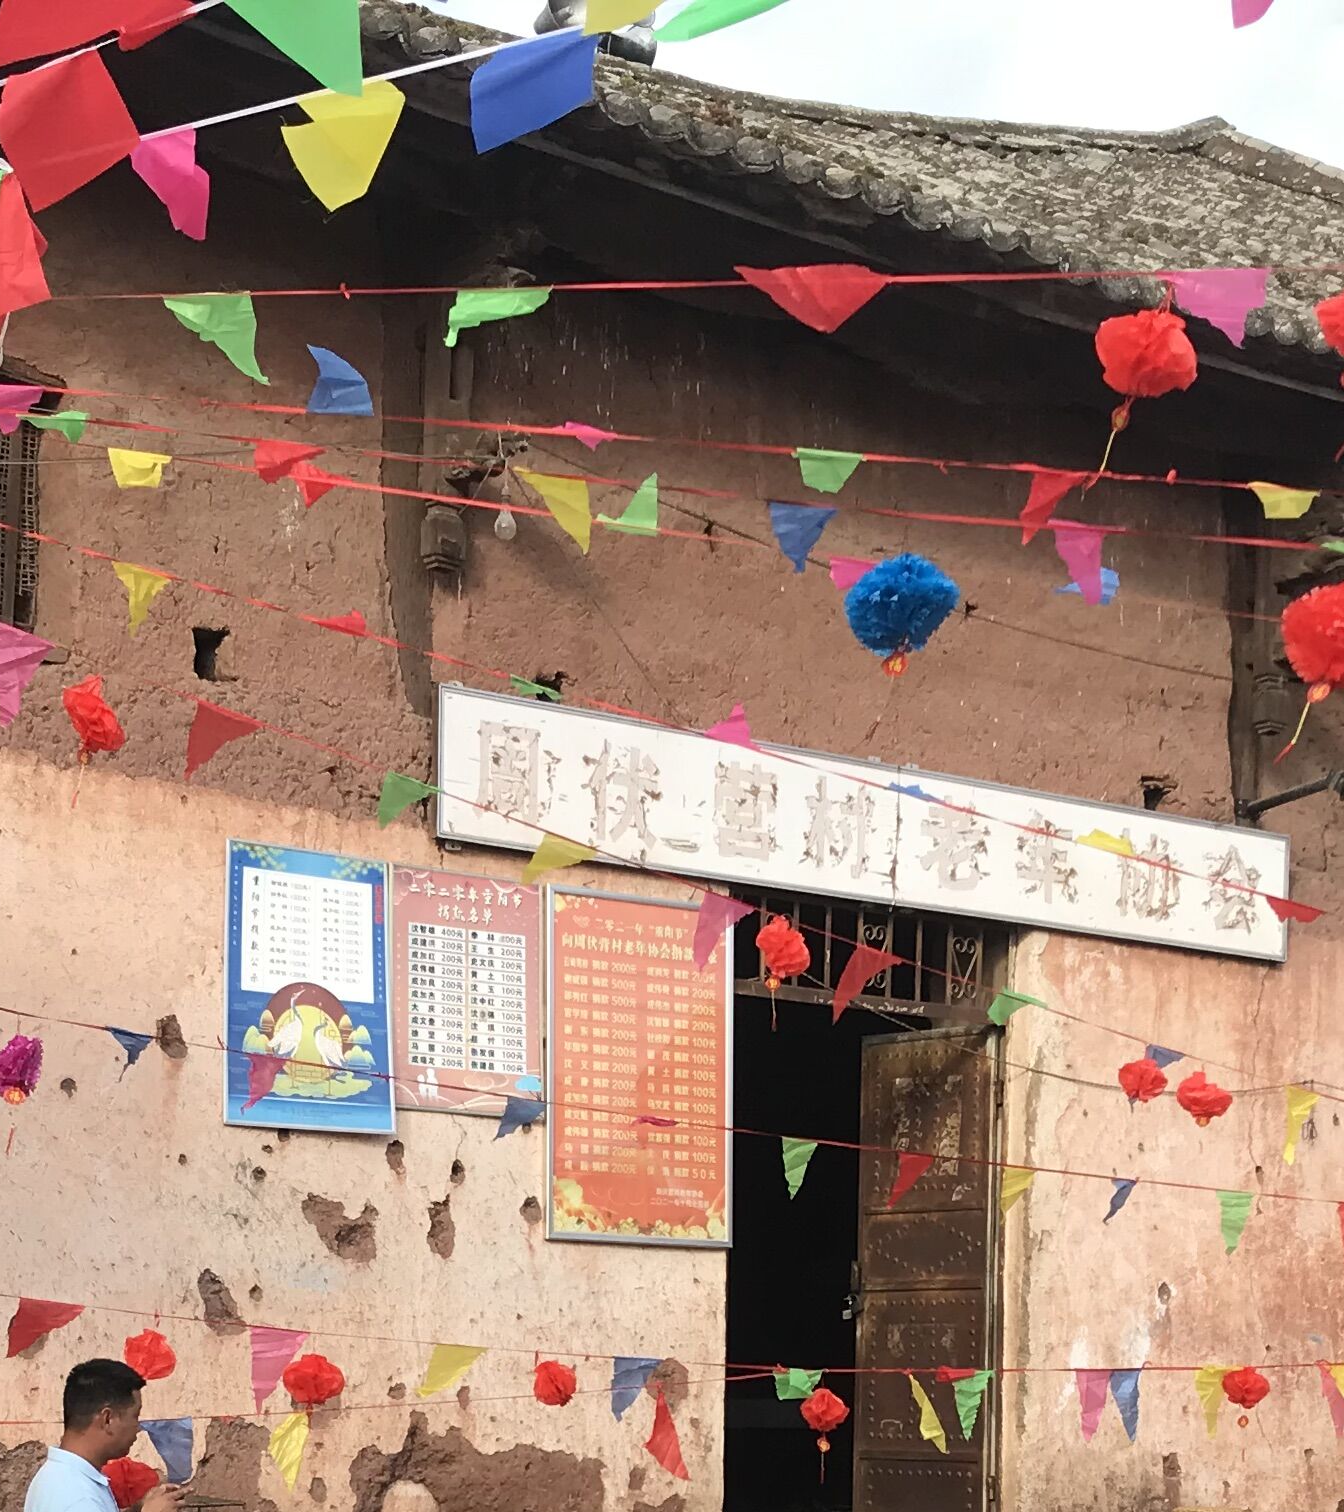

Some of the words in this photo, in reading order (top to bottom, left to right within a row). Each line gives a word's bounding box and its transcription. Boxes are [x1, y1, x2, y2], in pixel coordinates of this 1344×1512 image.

[441, 929, 464, 939] 400元
[441, 942, 464, 952] 200元
[562, 932, 718, 964] 向周伏营村老年协会捐款
[501, 949, 522, 958] 200元
[441, 955, 464, 964] 200元
[501, 962, 522, 971] 200元
[441, 968, 464, 977] 200元
[502, 974, 522, 984] 100元
[441, 981, 464, 990] 200元
[502, 987, 522, 997] 100元
[441, 993, 464, 1003] 200元
[501, 1000, 522, 1009] 200元
[441, 1007, 464, 1016] 200元
[502, 1013, 522, 1022] 100元
[441, 1020, 464, 1029] 200元
[502, 1026, 522, 1035] 100元
[446, 1033, 464, 1042] 50元
[502, 1039, 522, 1048] 100元
[441, 1045, 464, 1055] 200元
[502, 1052, 522, 1060] 100元
[441, 1058, 464, 1068] 200元
[502, 1064, 522, 1073] 100元
